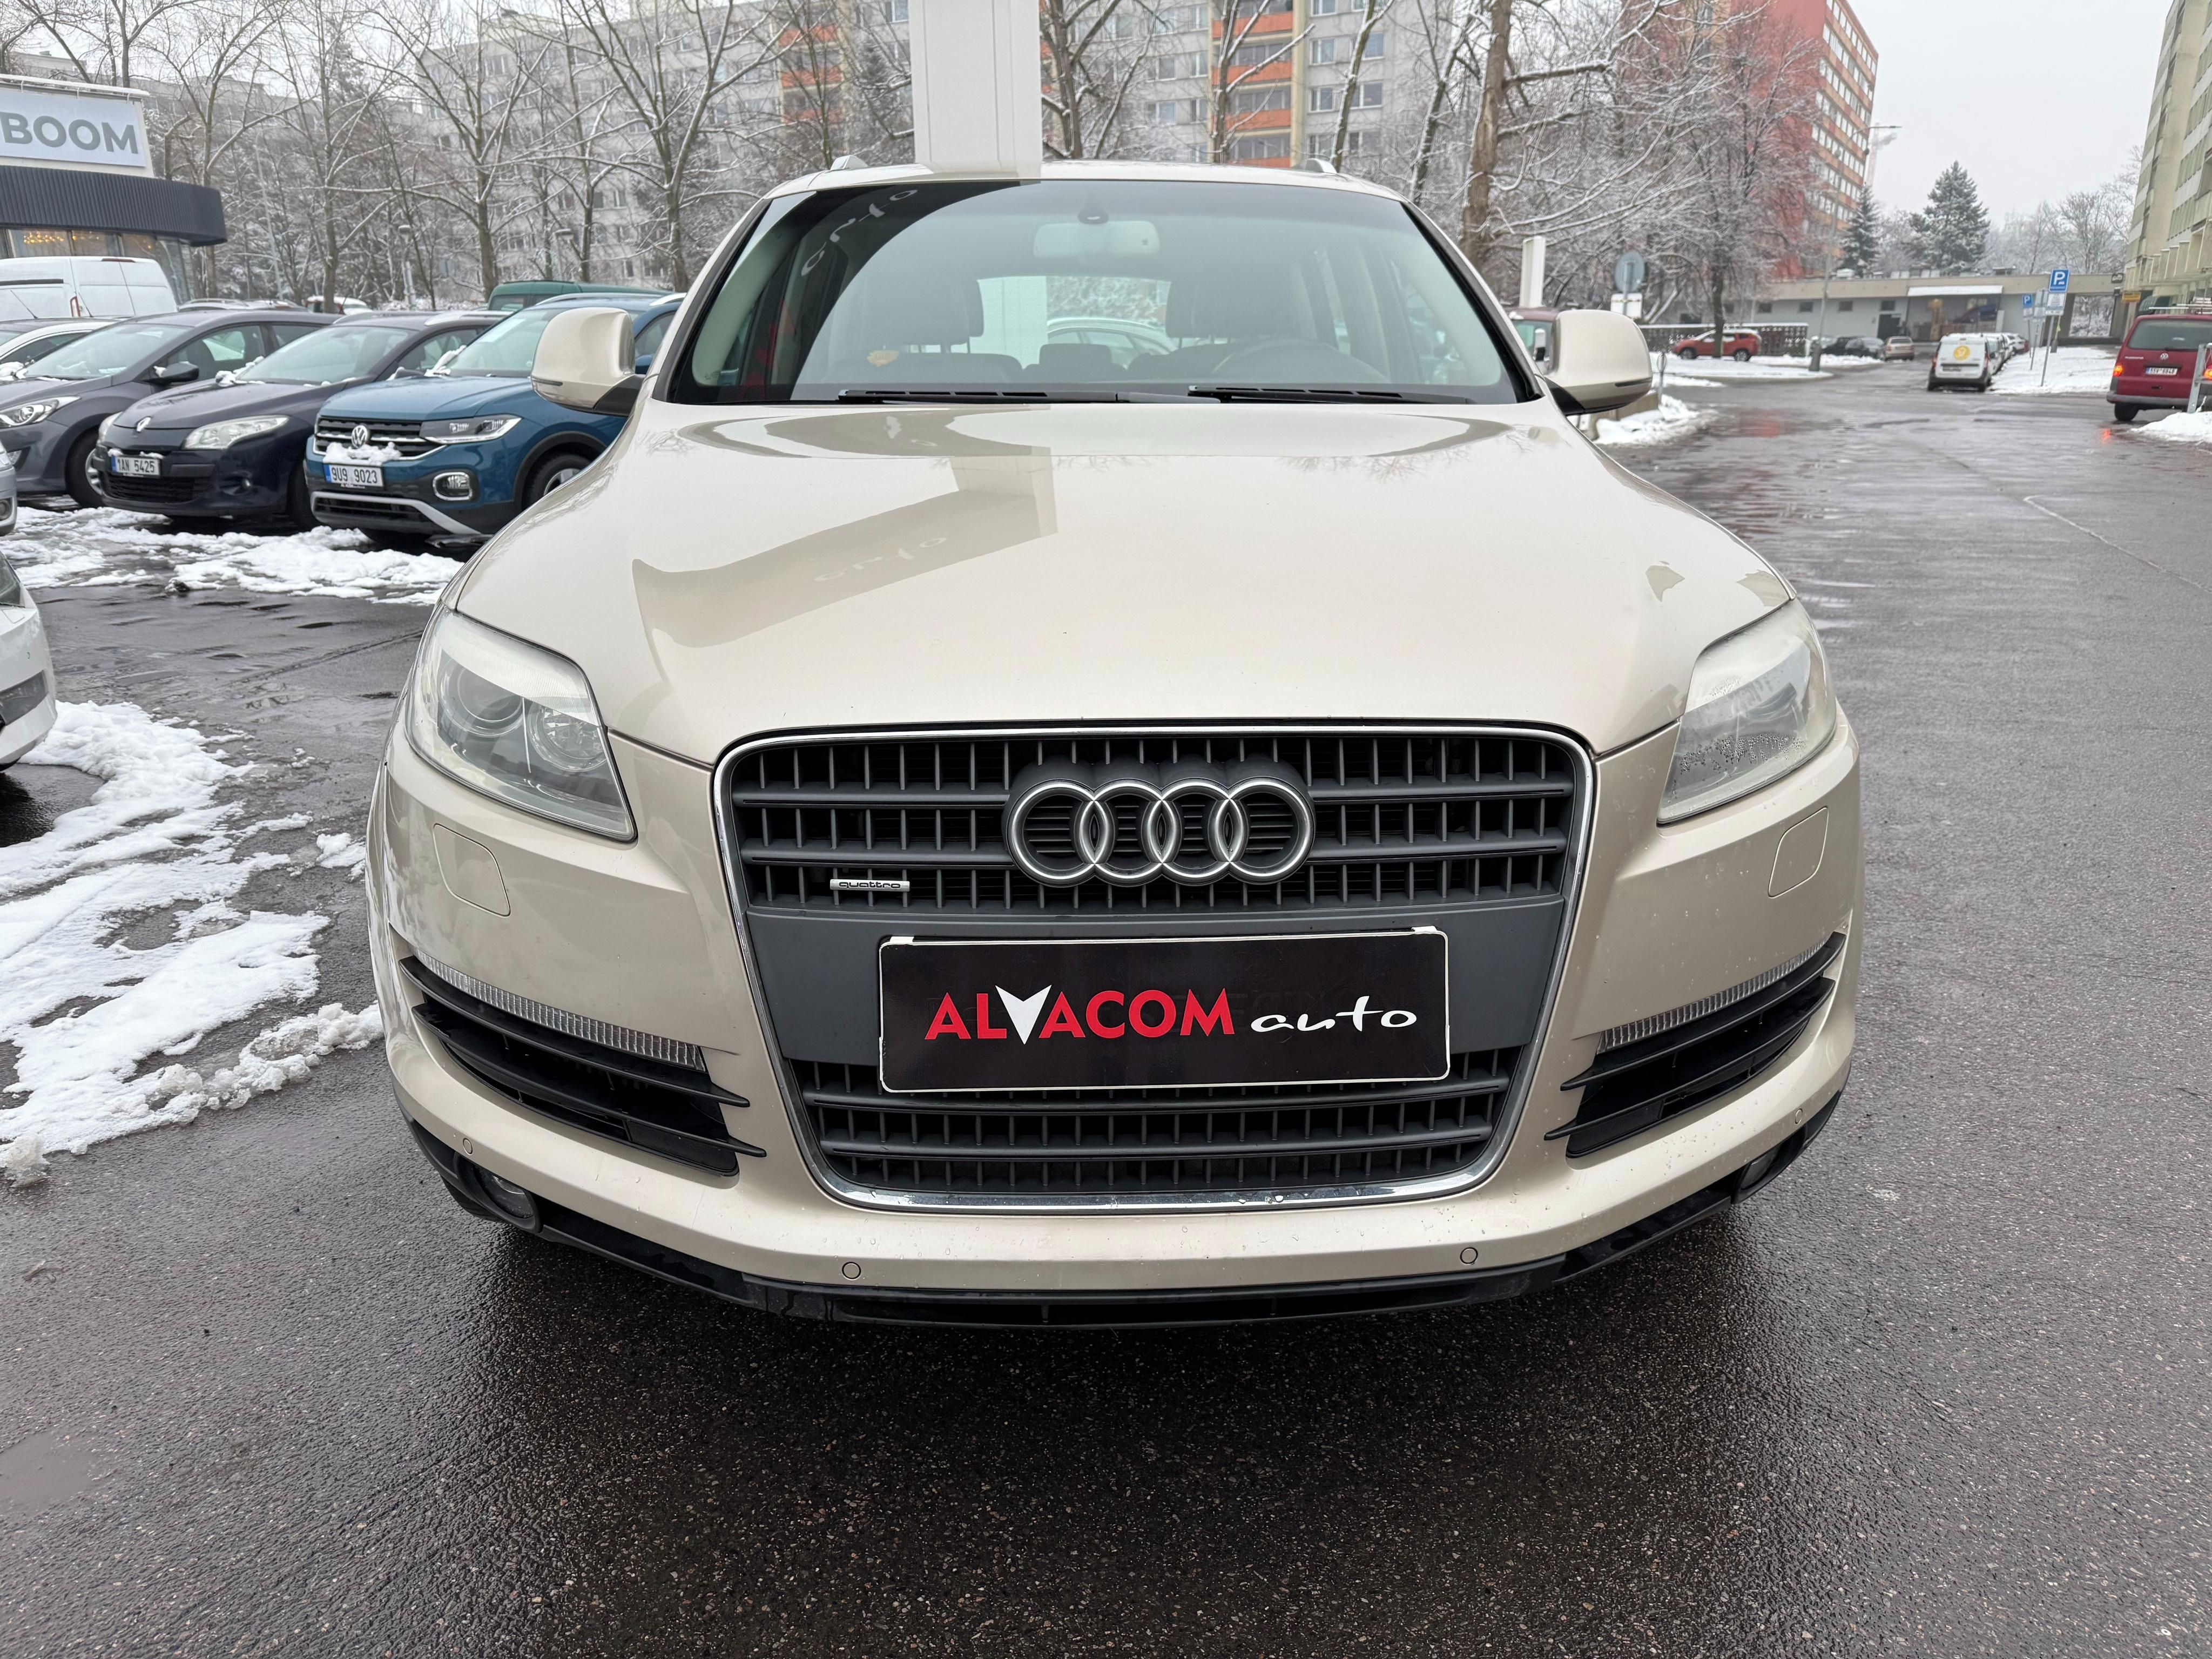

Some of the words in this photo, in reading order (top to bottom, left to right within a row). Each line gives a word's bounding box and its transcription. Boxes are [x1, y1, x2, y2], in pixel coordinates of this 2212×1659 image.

[0, 111, 139, 154] BOOM
[2053, 272, 2066, 285] P
[118, 458, 130, 471] 1AN
[134, 460, 155, 473] 5425
[331, 467, 348, 482] 9U9
[354, 469, 378, 484] 9023
[926, 985, 1235, 1044] ALVACOM
[1251, 995, 1417, 1033] auto
